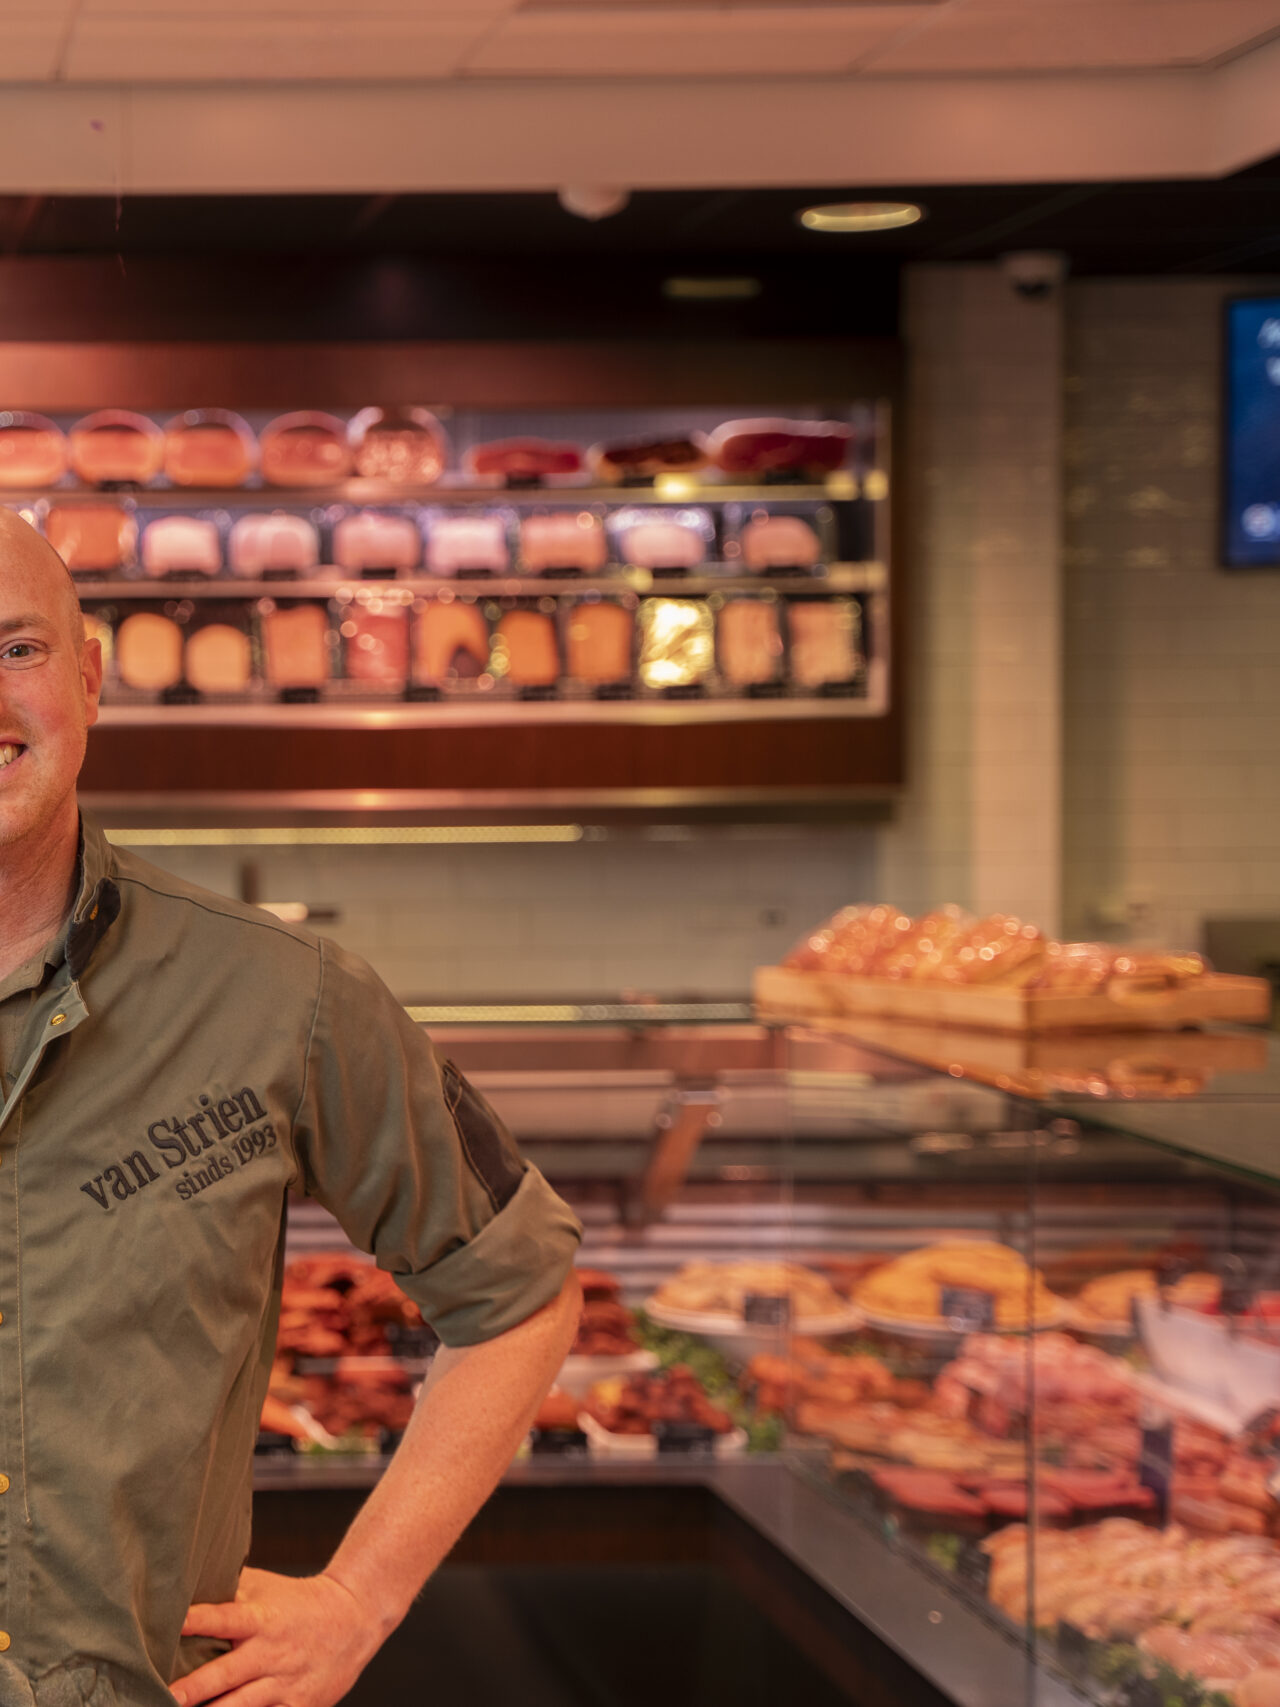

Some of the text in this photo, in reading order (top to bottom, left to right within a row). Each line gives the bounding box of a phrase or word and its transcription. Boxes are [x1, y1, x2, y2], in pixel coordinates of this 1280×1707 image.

[79, 1086, 268, 1210] van Strien
[175, 1124, 278, 1201] sinds 1993
